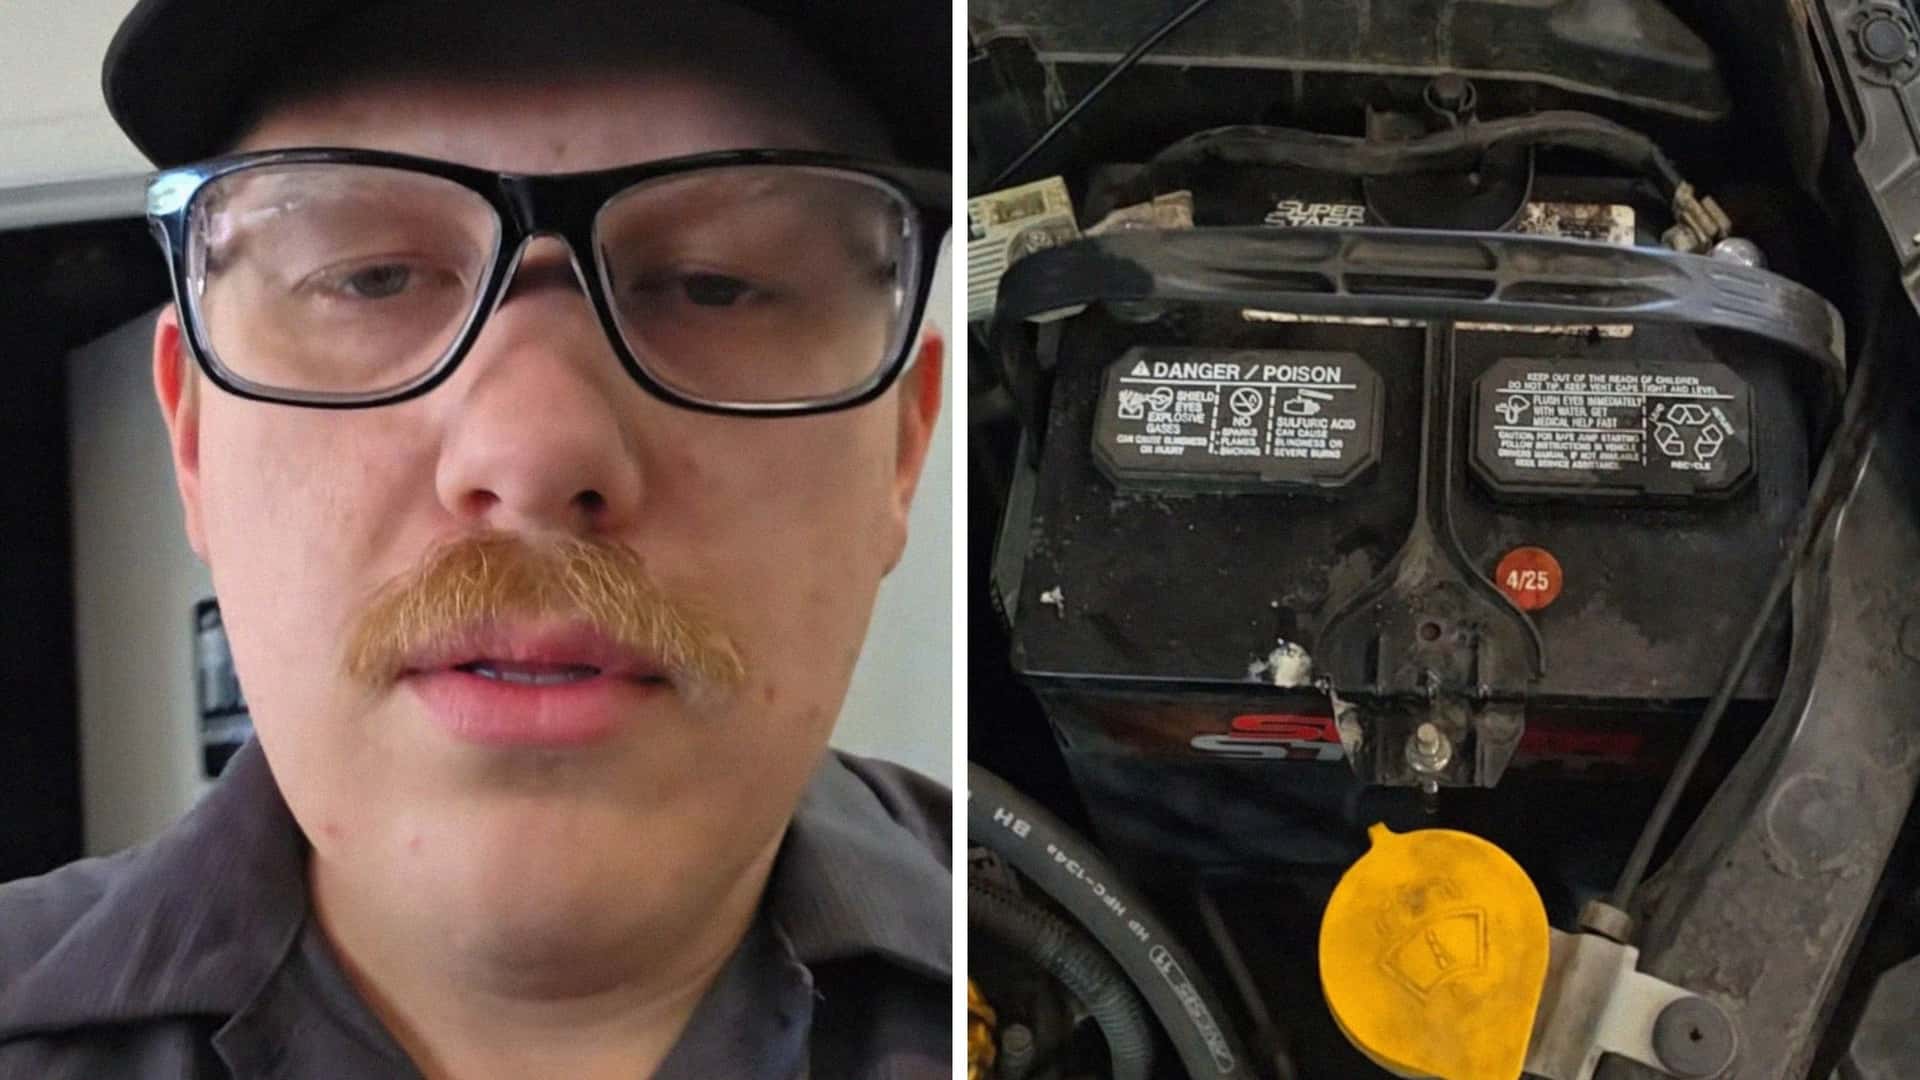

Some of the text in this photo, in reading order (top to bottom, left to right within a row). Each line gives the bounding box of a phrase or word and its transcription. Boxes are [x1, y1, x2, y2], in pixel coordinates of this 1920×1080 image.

[1277, 200, 1365, 223] SUPER
[1153, 361, 1342, 382] DANGER / POISON
[1526, 373, 1699, 385] KEEP OUT OF THE REACH OF CHILDREN
[1508, 380, 1522, 389] DO
[1524, 381, 1542, 390] NOT
[1564, 382, 1586, 391] KEEP
[1589, 383, 1612, 392] VENT
[1615, 384, 1639, 392] CAPS
[1642, 383, 1667, 393] TIGHT
[1670, 385, 1689, 393] AND
[1691, 385, 1718, 395] LEVEL
[1176, 390, 1215, 402] SHIELD
[1533, 395, 1642, 407] FLUSH EYES IMMEDIATELY
[1175, 401, 1203, 412] EYES
[1533, 406, 1555, 416] WITH
[1590, 407, 1607, 417] GET
[1148, 411, 1205, 424] EXPLOSIVE
[1232, 416, 1252, 427] NO
[1276, 416, 1356, 430] SULFURIC ACID
[1533, 416, 1617, 428] MEDICAL HELP FAST
[1146, 423, 1181, 434] GASES
[1221, 427, 1258, 437] SPARKS
[1275, 428, 1328, 438] CAN CAUSE
[1220, 437, 1257, 446] FLAMES
[1536, 432, 1553, 441] FOR
[1274, 438, 1343, 448] BLINDNESS OR
[1501, 440, 1534, 448] FOLLOW
[1535, 441, 1591, 450] INSTRUCTIONS
[1273, 447, 1308, 457] SEVERE
[1580, 451, 1597, 460] NOT
[1670, 460, 1712, 470] RECYCLE
[1506, 569, 1549, 591] 4/25
[993, 807, 1033, 839] BH
[1128, 918, 1150, 943] HP
